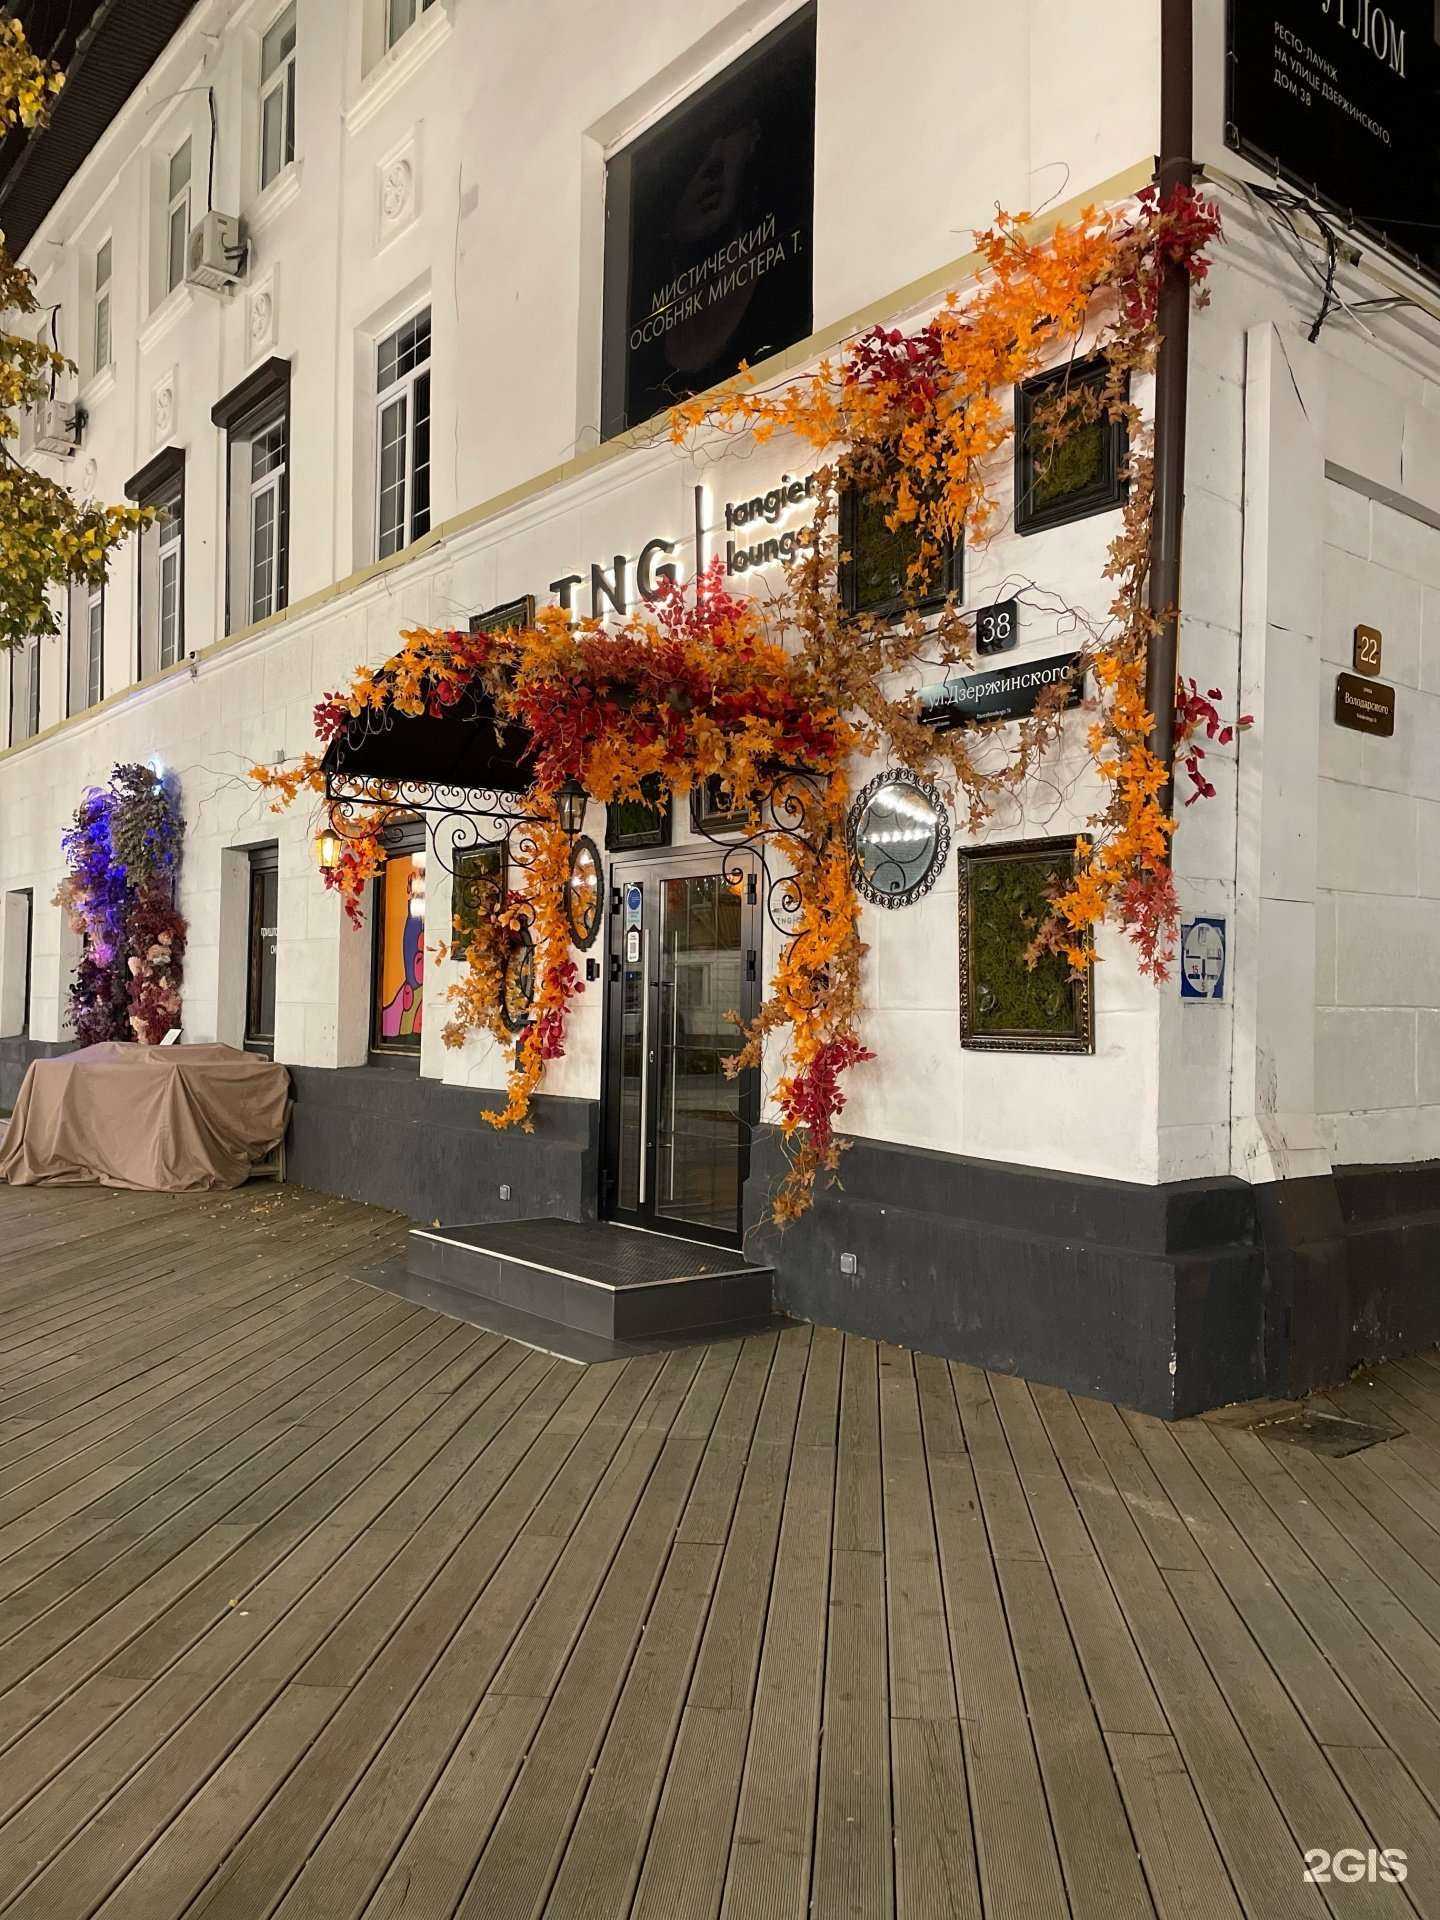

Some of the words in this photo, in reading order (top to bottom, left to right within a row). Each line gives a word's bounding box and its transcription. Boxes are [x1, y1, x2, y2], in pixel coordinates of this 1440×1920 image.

[1274, 21, 1338, 81] РЕСТО-ЛАУНЖ
[1274, 44, 1288, 65] НА
[1290, 55, 1321, 91] УЛИЦЕ
[1273, 68, 1298, 96] ДОМ
[1300, 88, 1312, 106] 38
[630, 290, 704, 350] ОСОБНЯК
[708, 242, 786, 305] МИСТЕРА
[791, 230, 803, 254] Т.
[651, 212, 776, 312] МИСТИЧЕСКИЙ
[725, 472, 815, 531] tangier
[549, 538, 677, 632] TNG
[982, 612, 1011, 643] 38
[1360, 636, 1377, 665] 22
